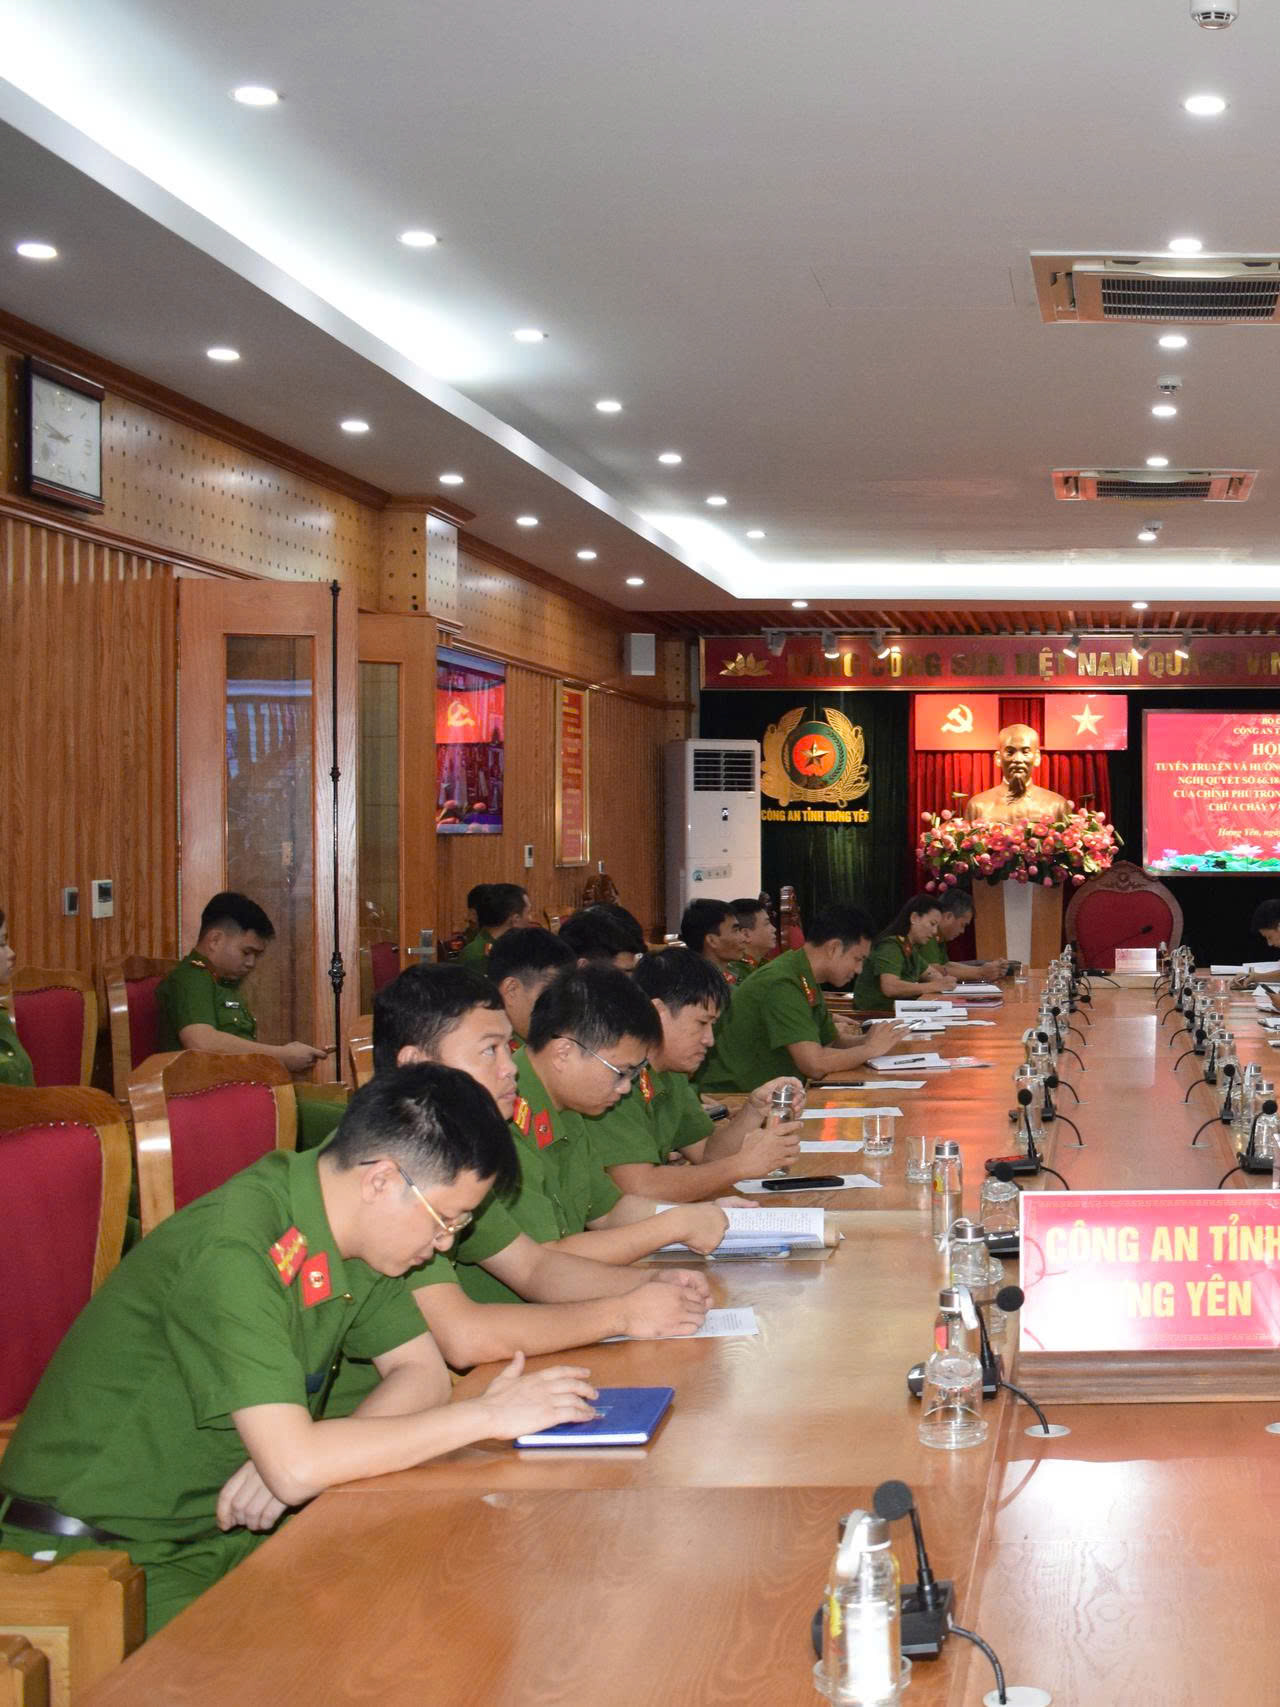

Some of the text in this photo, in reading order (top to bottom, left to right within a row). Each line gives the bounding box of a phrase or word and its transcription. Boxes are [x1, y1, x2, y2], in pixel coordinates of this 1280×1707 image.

[1233, 726, 1259, 735] CÔNG
[1260, 727, 1273, 735] AN
[1178, 776, 1204, 786] NGHỊ
[1196, 788, 1229, 798] CHÍNH
[761, 808, 786, 821] CÔNG
[787, 810, 801, 821] AN
[1046, 1220, 1140, 1262] CÔNG
[1151, 1226, 1198, 1262] AN
[1186, 1273, 1252, 1317] YÊN
